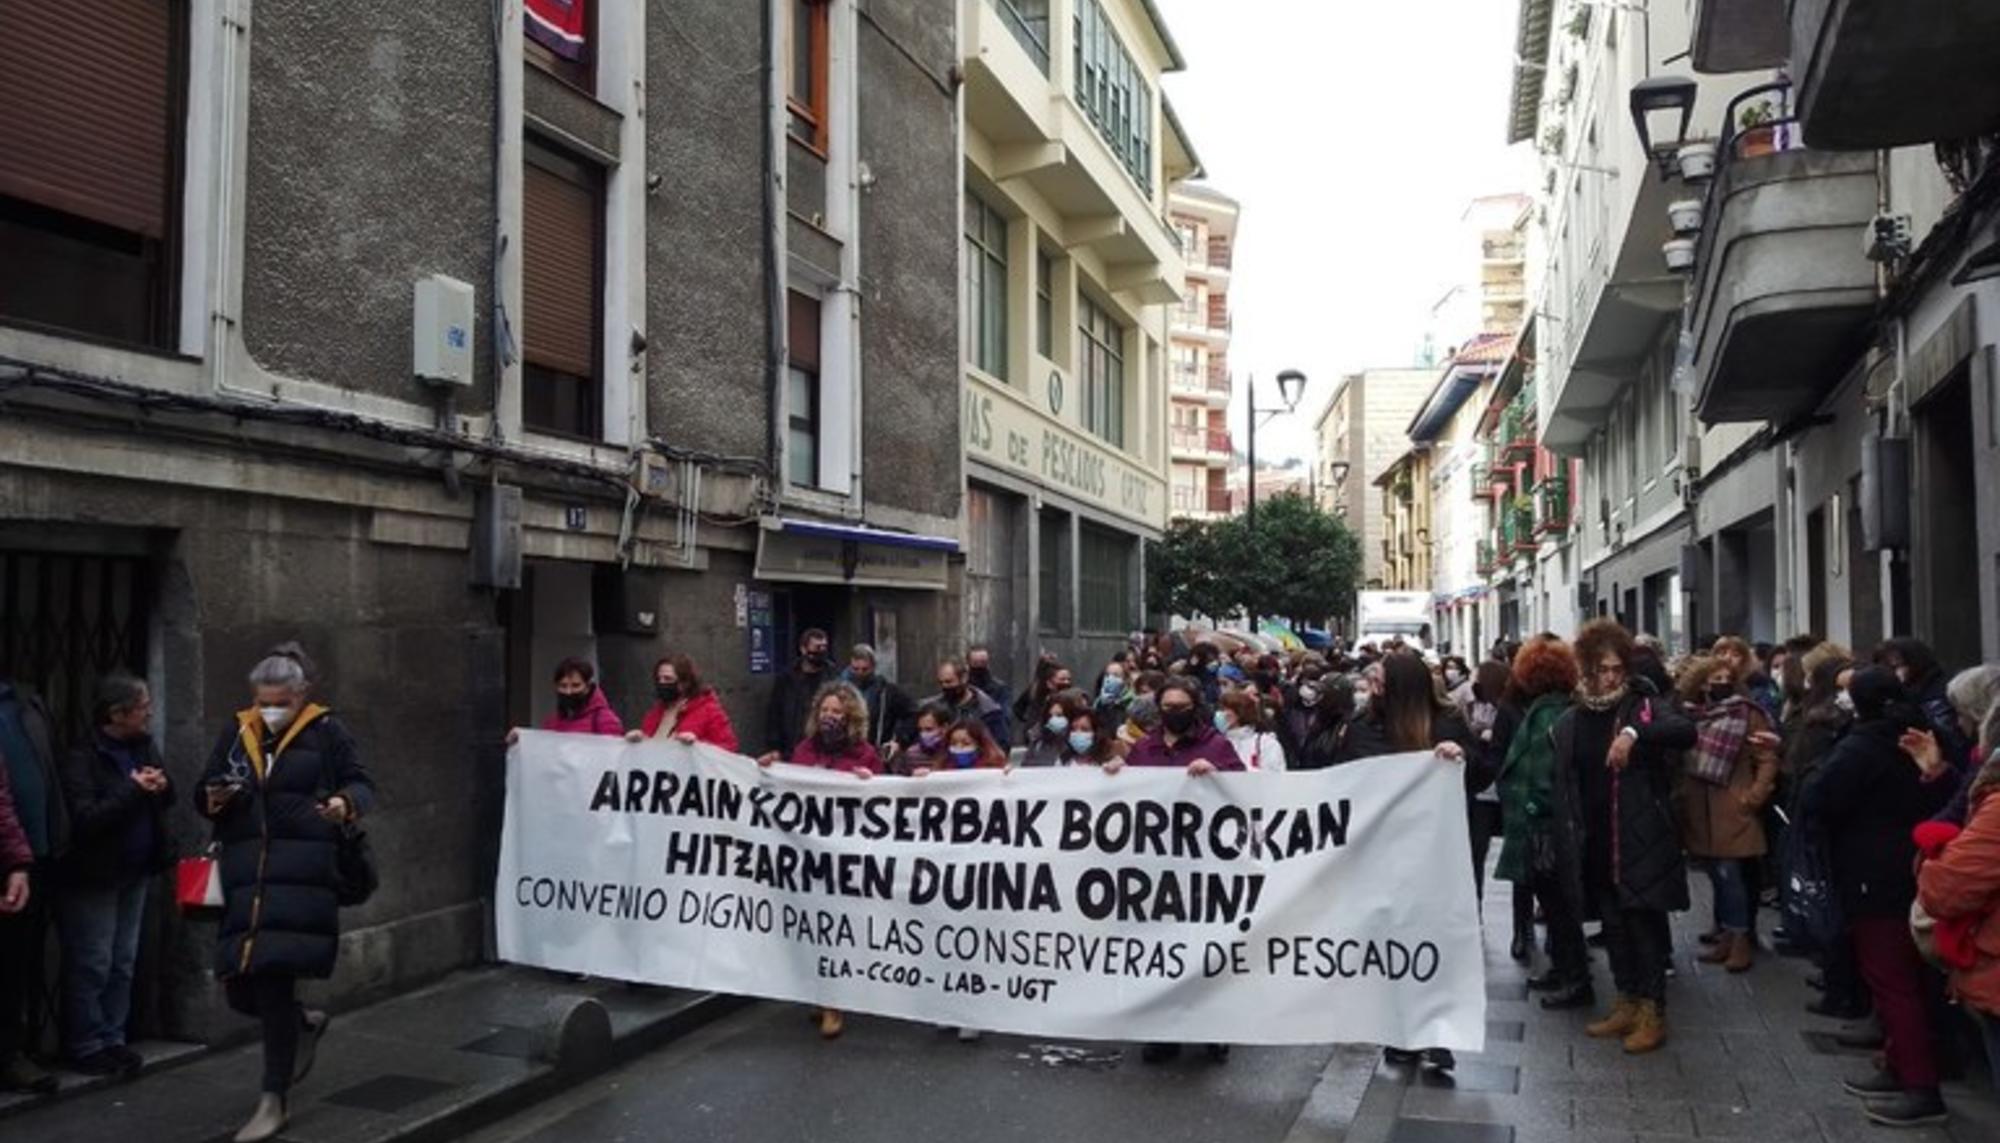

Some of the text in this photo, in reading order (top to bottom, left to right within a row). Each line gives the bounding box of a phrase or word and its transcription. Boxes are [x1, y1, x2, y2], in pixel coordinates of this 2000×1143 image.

[1007, 430, 1028, 467] DE
[590, 769, 1351, 862] ARRAIN KONTSERBAK BORROKAN
[515, 876, 1440, 982] CONVENIO DIGNO PARA LAS CONSERVERAS DE PESCADO
[666, 831, 1266, 932] HITZARMEN DUINA ORAIN!
